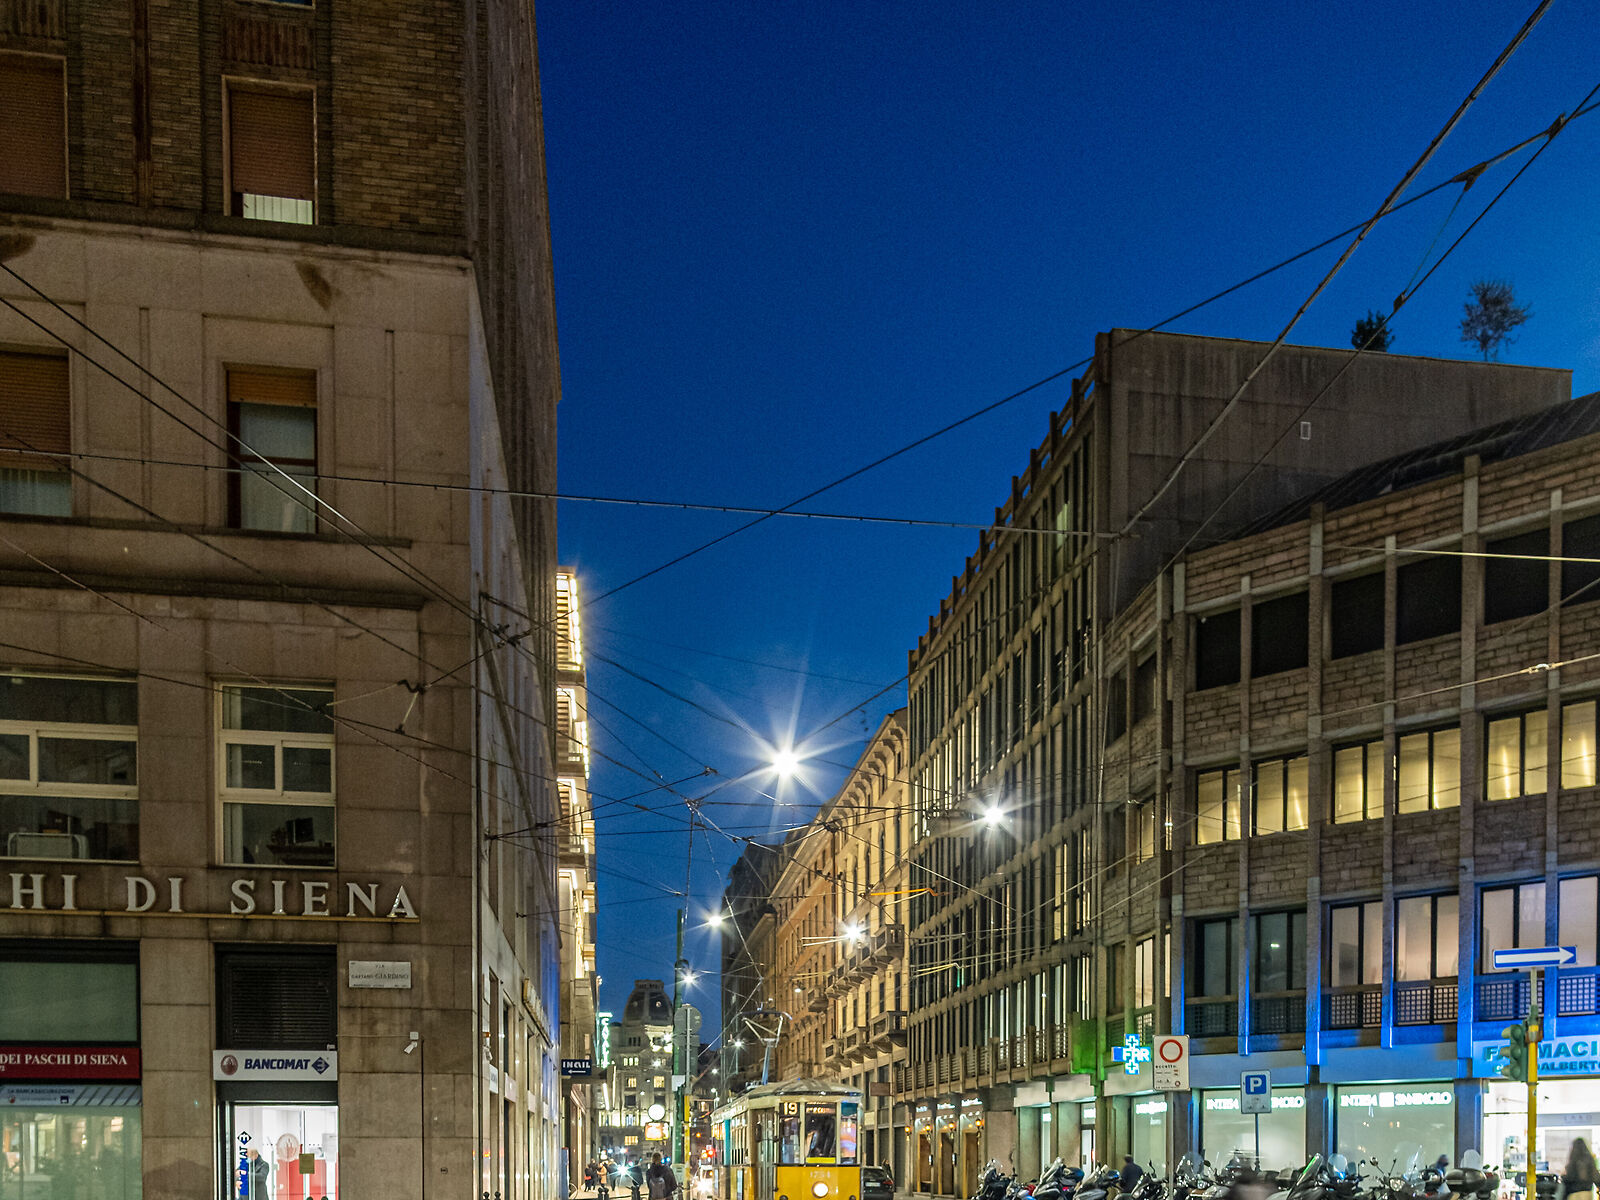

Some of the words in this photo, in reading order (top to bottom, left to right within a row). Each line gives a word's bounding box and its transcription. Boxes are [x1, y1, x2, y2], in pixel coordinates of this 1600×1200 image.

[9, 873, 78, 910] HI
[125, 876, 184, 912] DI
[230, 879, 418, 918] SIENA
[0, 1053, 21, 1065] DEI
[24, 1054, 71, 1065] PASCHI
[74, 1054, 87, 1065] DI
[90, 1054, 127, 1065] SIENA
[1123, 1048, 1150, 1061] FAR
[244, 1058, 310, 1070] BANCOMAT
[563, 1061, 591, 1069] INAIL
[1250, 1077, 1263, 1092] P
[783, 1102, 798, 1115] 19
